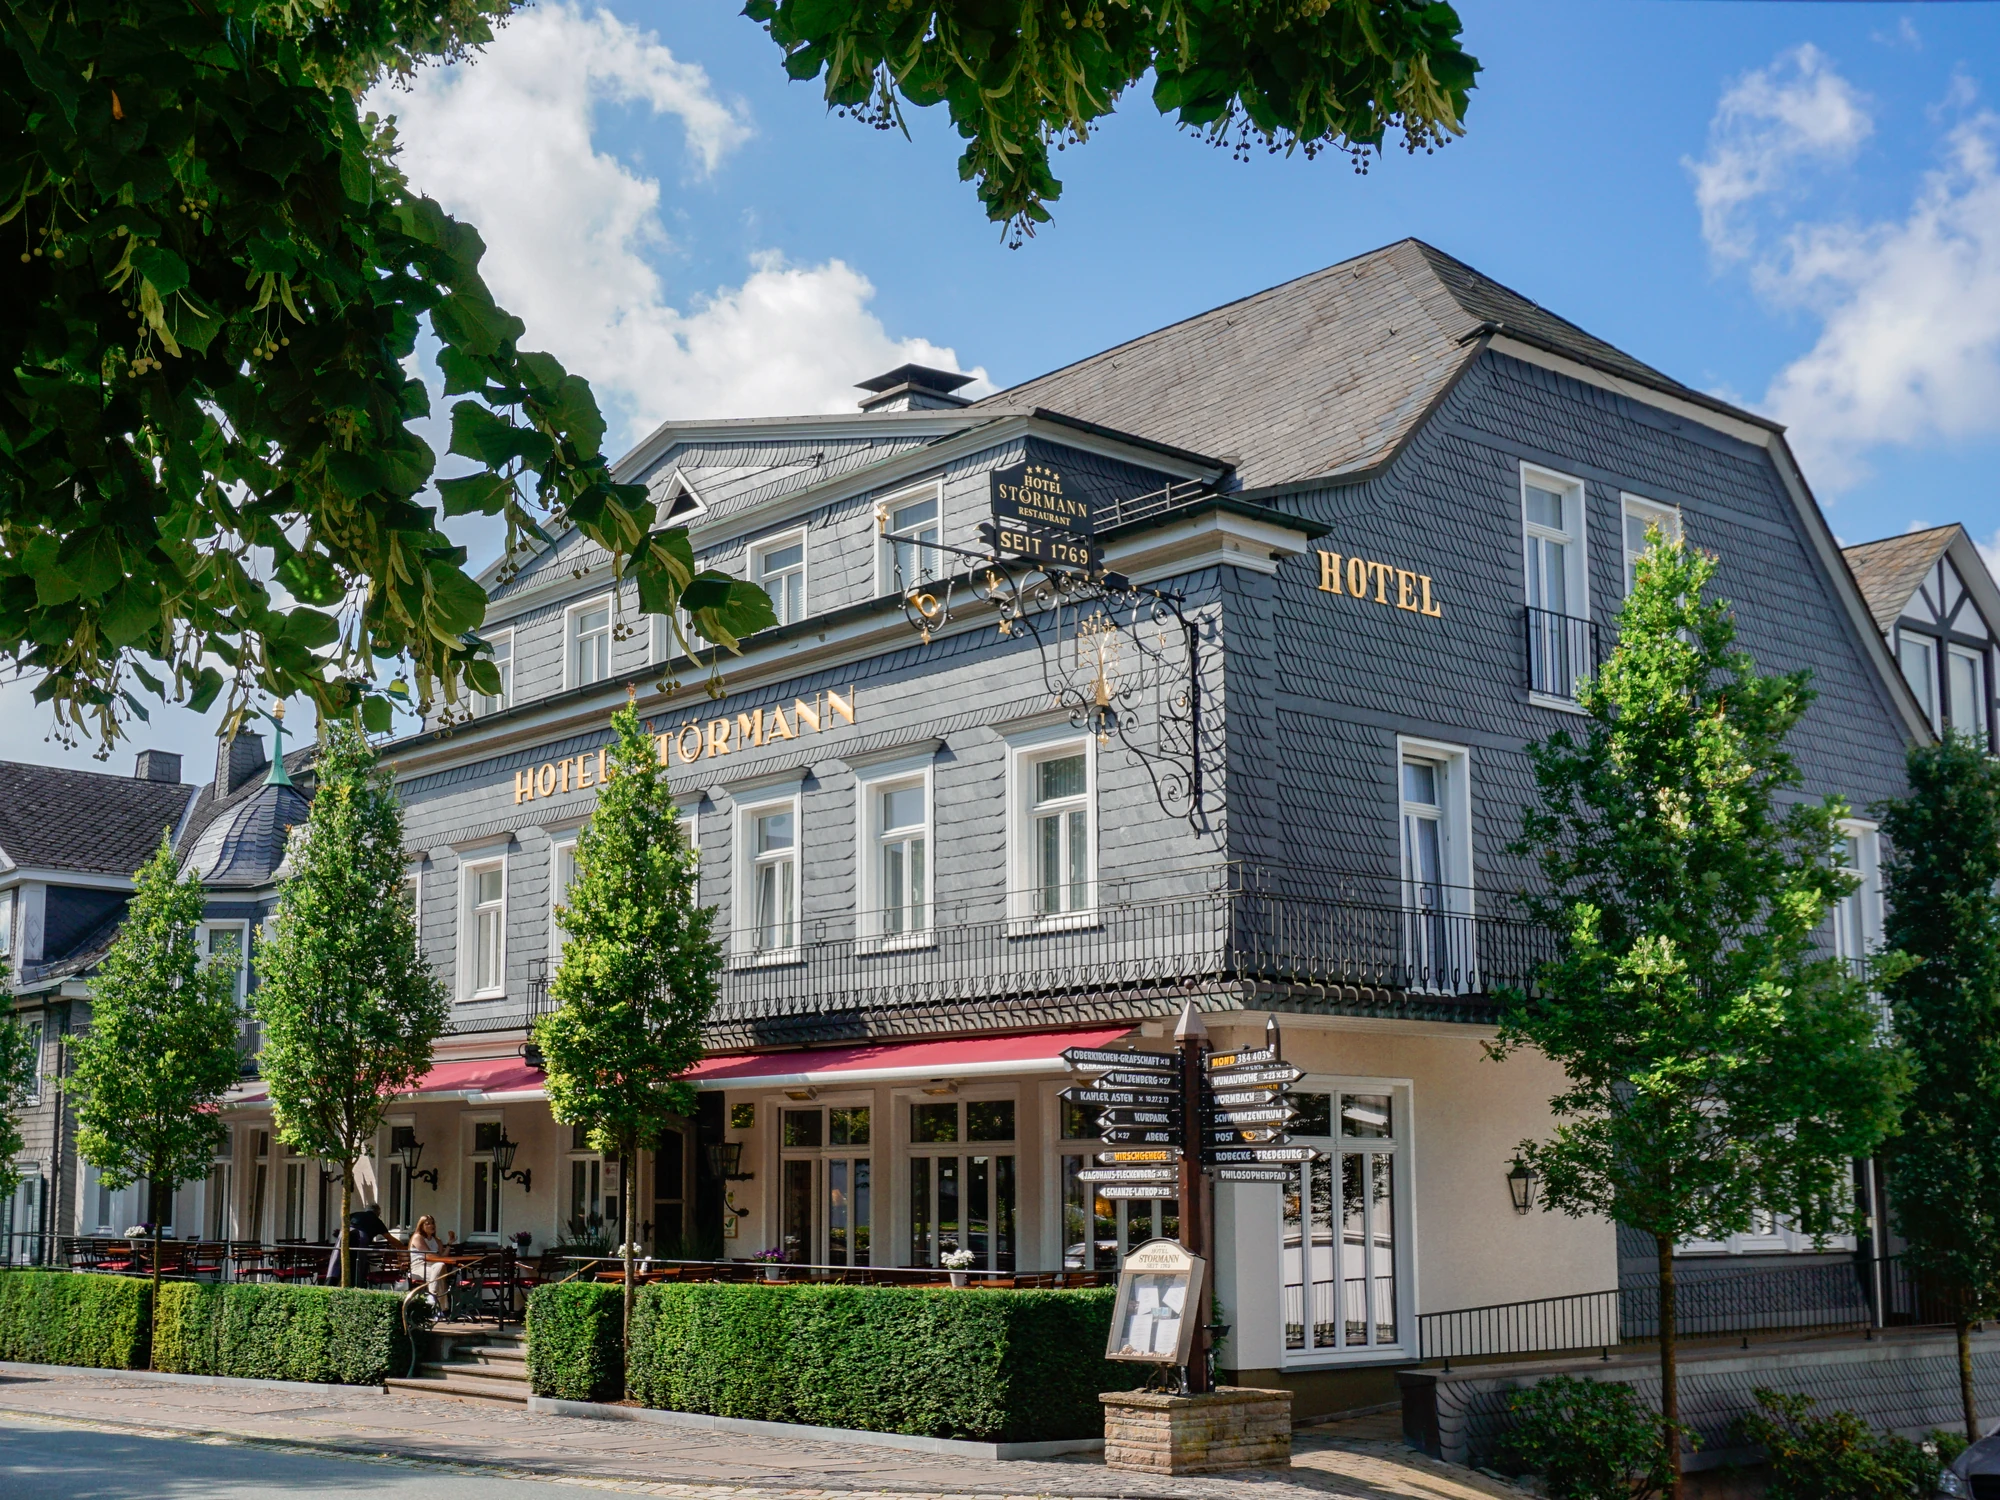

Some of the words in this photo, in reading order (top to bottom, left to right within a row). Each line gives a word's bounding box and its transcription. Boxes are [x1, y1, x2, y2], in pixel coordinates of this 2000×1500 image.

[1024, 475, 1063, 495] HOTEL
[999, 483, 1087, 518] STÖRMANN
[1018, 506, 1071, 526] RESTAURANT
[1000, 531, 1042, 555] SEIT
[1051, 543, 1088, 565] 1769
[1317, 549, 1442, 618] HOTEL
[514, 749, 608, 804] HOTEL
[635, 684, 856, 776] TÖRMANN
[1073, 1050, 1160, 1066] OBERKIRCHEN-GRAFSCHAFT
[1212, 1055, 1235, 1067] MOND
[1114, 1073, 1158, 1085] WILZENBERG
[1080, 1091, 1109, 1102] KAHLER
[1110, 1093, 1134, 1103] ASTEN
[1213, 1092, 1255, 1105] WORMBACH
[1134, 1112, 1170, 1123] KURPARK
[1214, 1109, 1283, 1123] SCHWIMMZENTRUM
[1145, 1132, 1169, 1142] ABERG
[1215, 1132, 1234, 1142] POST
[1114, 1150, 1168, 1161] HIRSCHGEHEGE
[1083, 1169, 1156, 1180] JAGDHAUS-FLECKENBERG
[1221, 1170, 1287, 1181] PHILOSOPHENPFAD
[1106, 1187, 1157, 1196] SCHANZE-LATROP
